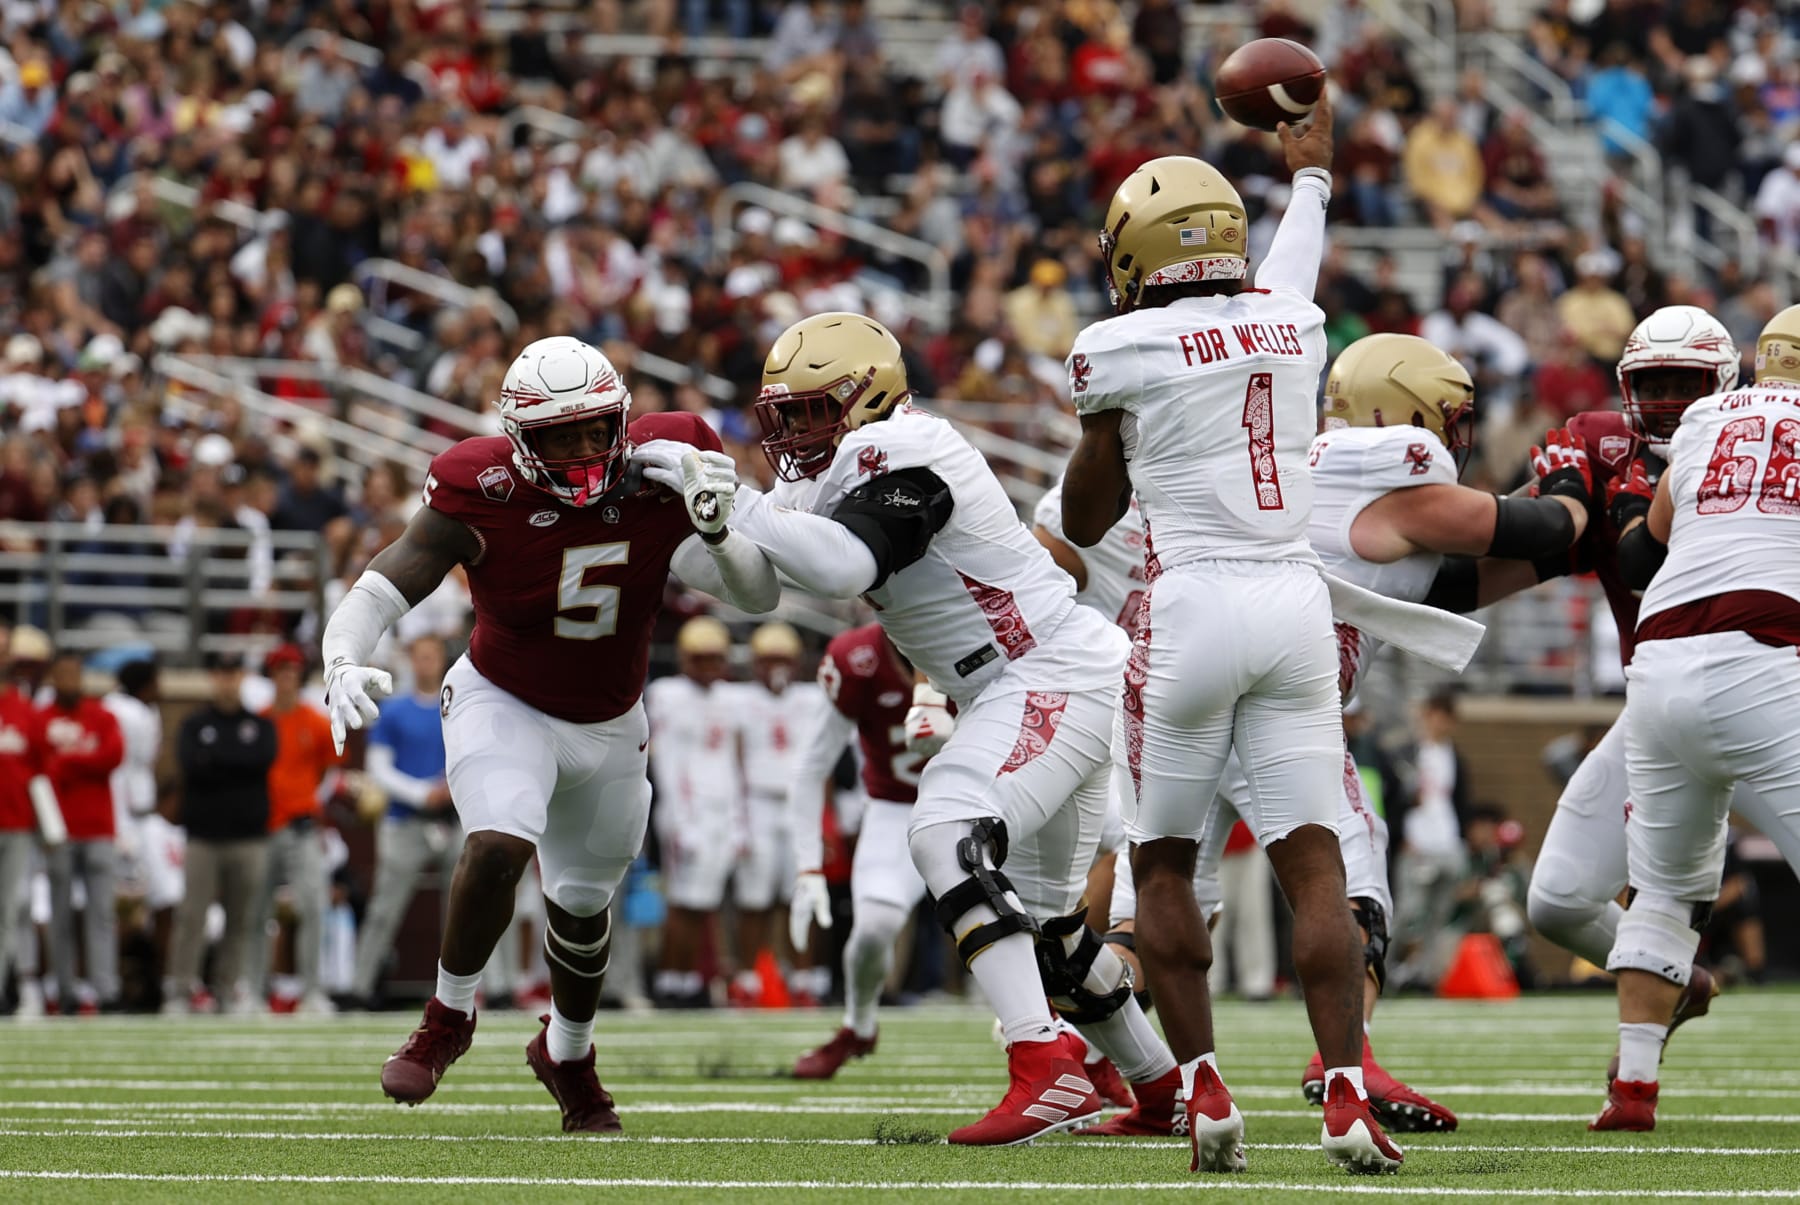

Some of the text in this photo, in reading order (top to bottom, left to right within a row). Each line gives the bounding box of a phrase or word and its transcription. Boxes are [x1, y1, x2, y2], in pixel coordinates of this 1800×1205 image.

[1178, 324, 1303, 366] FOR WELLES
[1241, 372, 1284, 511] 1
[532, 511, 558, 524] ACC
[554, 541, 630, 639] 5
